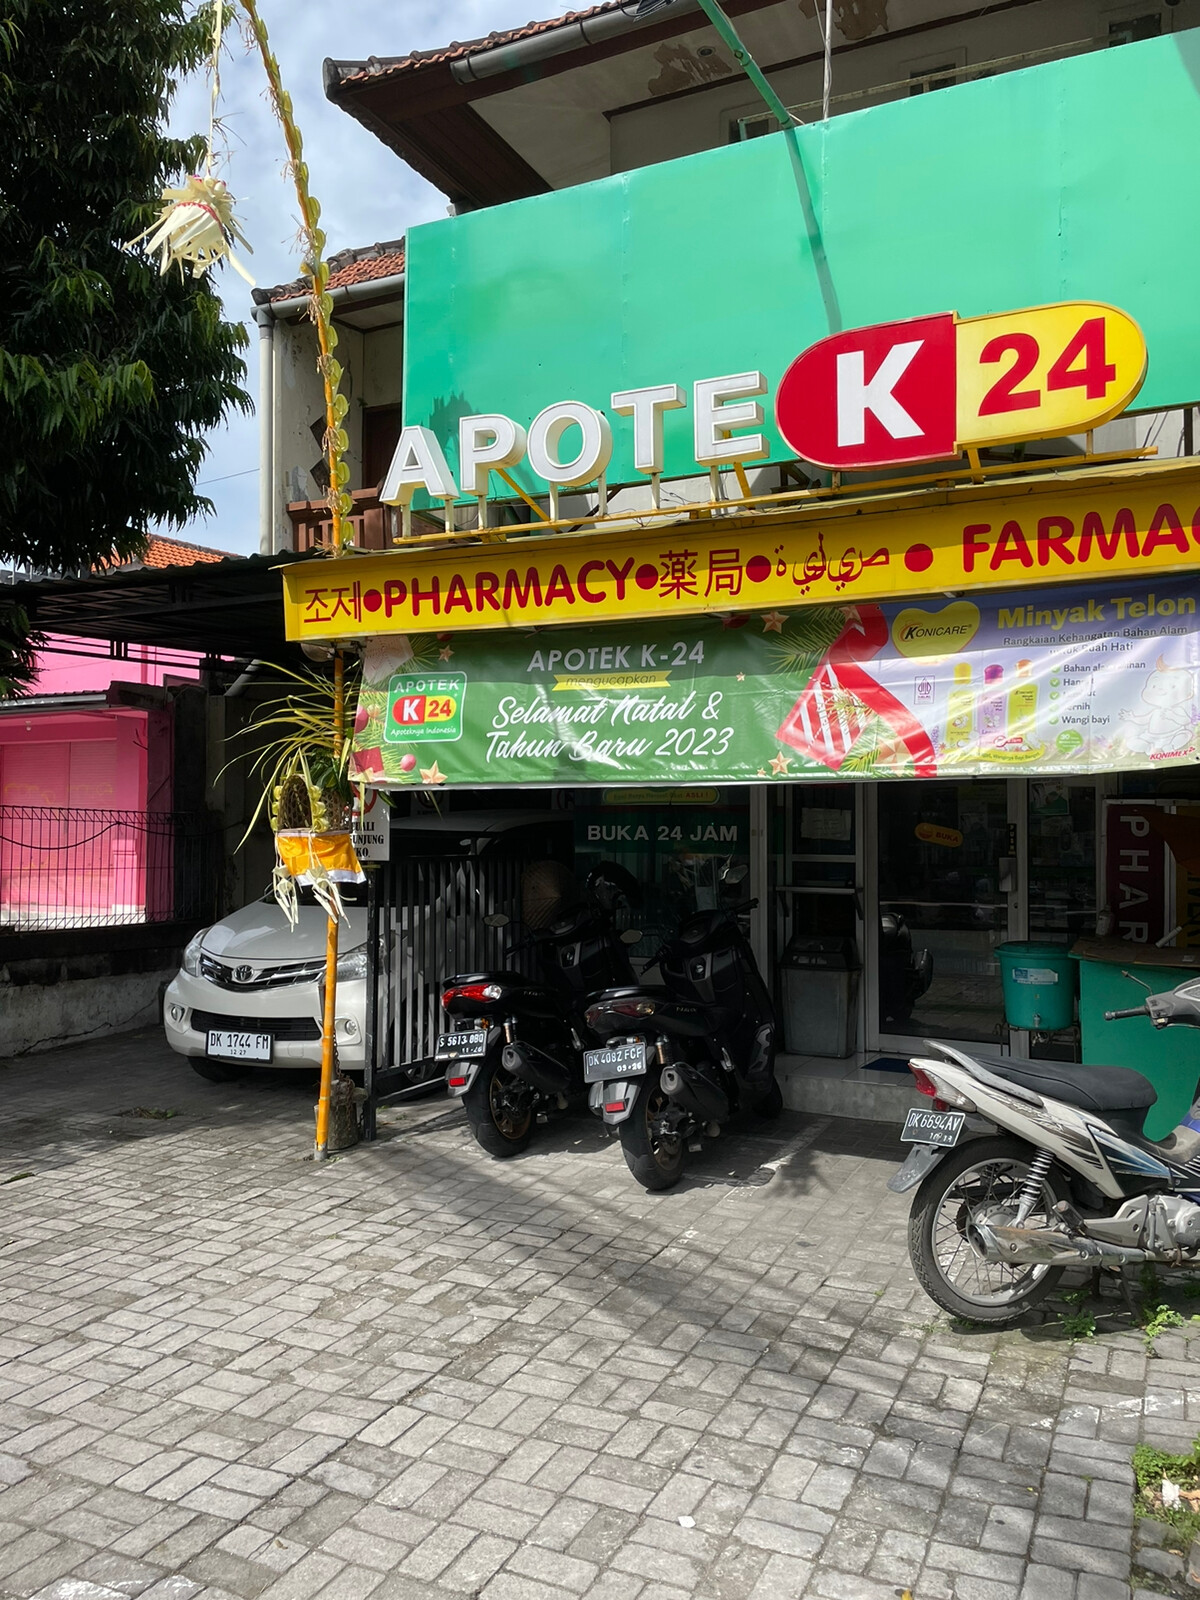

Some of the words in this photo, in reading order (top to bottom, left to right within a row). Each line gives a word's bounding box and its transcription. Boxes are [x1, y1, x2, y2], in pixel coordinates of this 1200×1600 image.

[978, 316, 1116, 418] 24
[962, 503, 1200, 573] FARMA
[658, 547, 743, 600] 薬局
[384, 556, 635, 619] PHARMACY
[303, 580, 362, 624] 조제
[997, 600, 1106, 631] Minyak
[1110, 593, 1197, 621] Telon
[1003, 635, 1056, 647] Rangkaian
[1058, 630, 1120, 643] Kehangatan
[1123, 627, 1157, 638] Bahan
[1159, 625, 1188, 635] Alam
[1110, 641, 1134, 651] Hati
[526, 644, 632, 672] APOTEK
[641, 640, 705, 667] K-24
[1063, 663, 1091, 673] Bahan
[394, 679, 461, 694] APOTEK
[565, 674, 657, 688] mengucapkan
[427, 699, 452, 718] 24
[492, 695, 608, 730] Selamat
[610, 690, 697, 727] Natal
[701, 690, 724, 720] &
[426, 725, 457, 735] Indonesia
[1061, 716, 1090, 726] Wangi
[1092, 715, 1110, 726] bayi
[485, 730, 569, 763] Tahun
[568, 729, 654, 763] Baru
[654, 726, 735, 757] 2023
[587, 825, 649, 841] BUKA
[657, 825, 683, 841] 24
[689, 825, 738, 842] JAM
[935, 831, 959, 844] BUKA
[210, 1032, 222, 1047] DK
[227, 1033, 251, 1048] 1744
[255, 1035, 269, 1049] FM
[588, 1055, 600, 1067] DK
[601, 1050, 623, 1064] 4082
[624, 1046, 643, 1060] FCF
[907, 1112, 923, 1128] DK
[920, 1114, 948, 1130] 6694
[944, 1116, 962, 1131] AV
